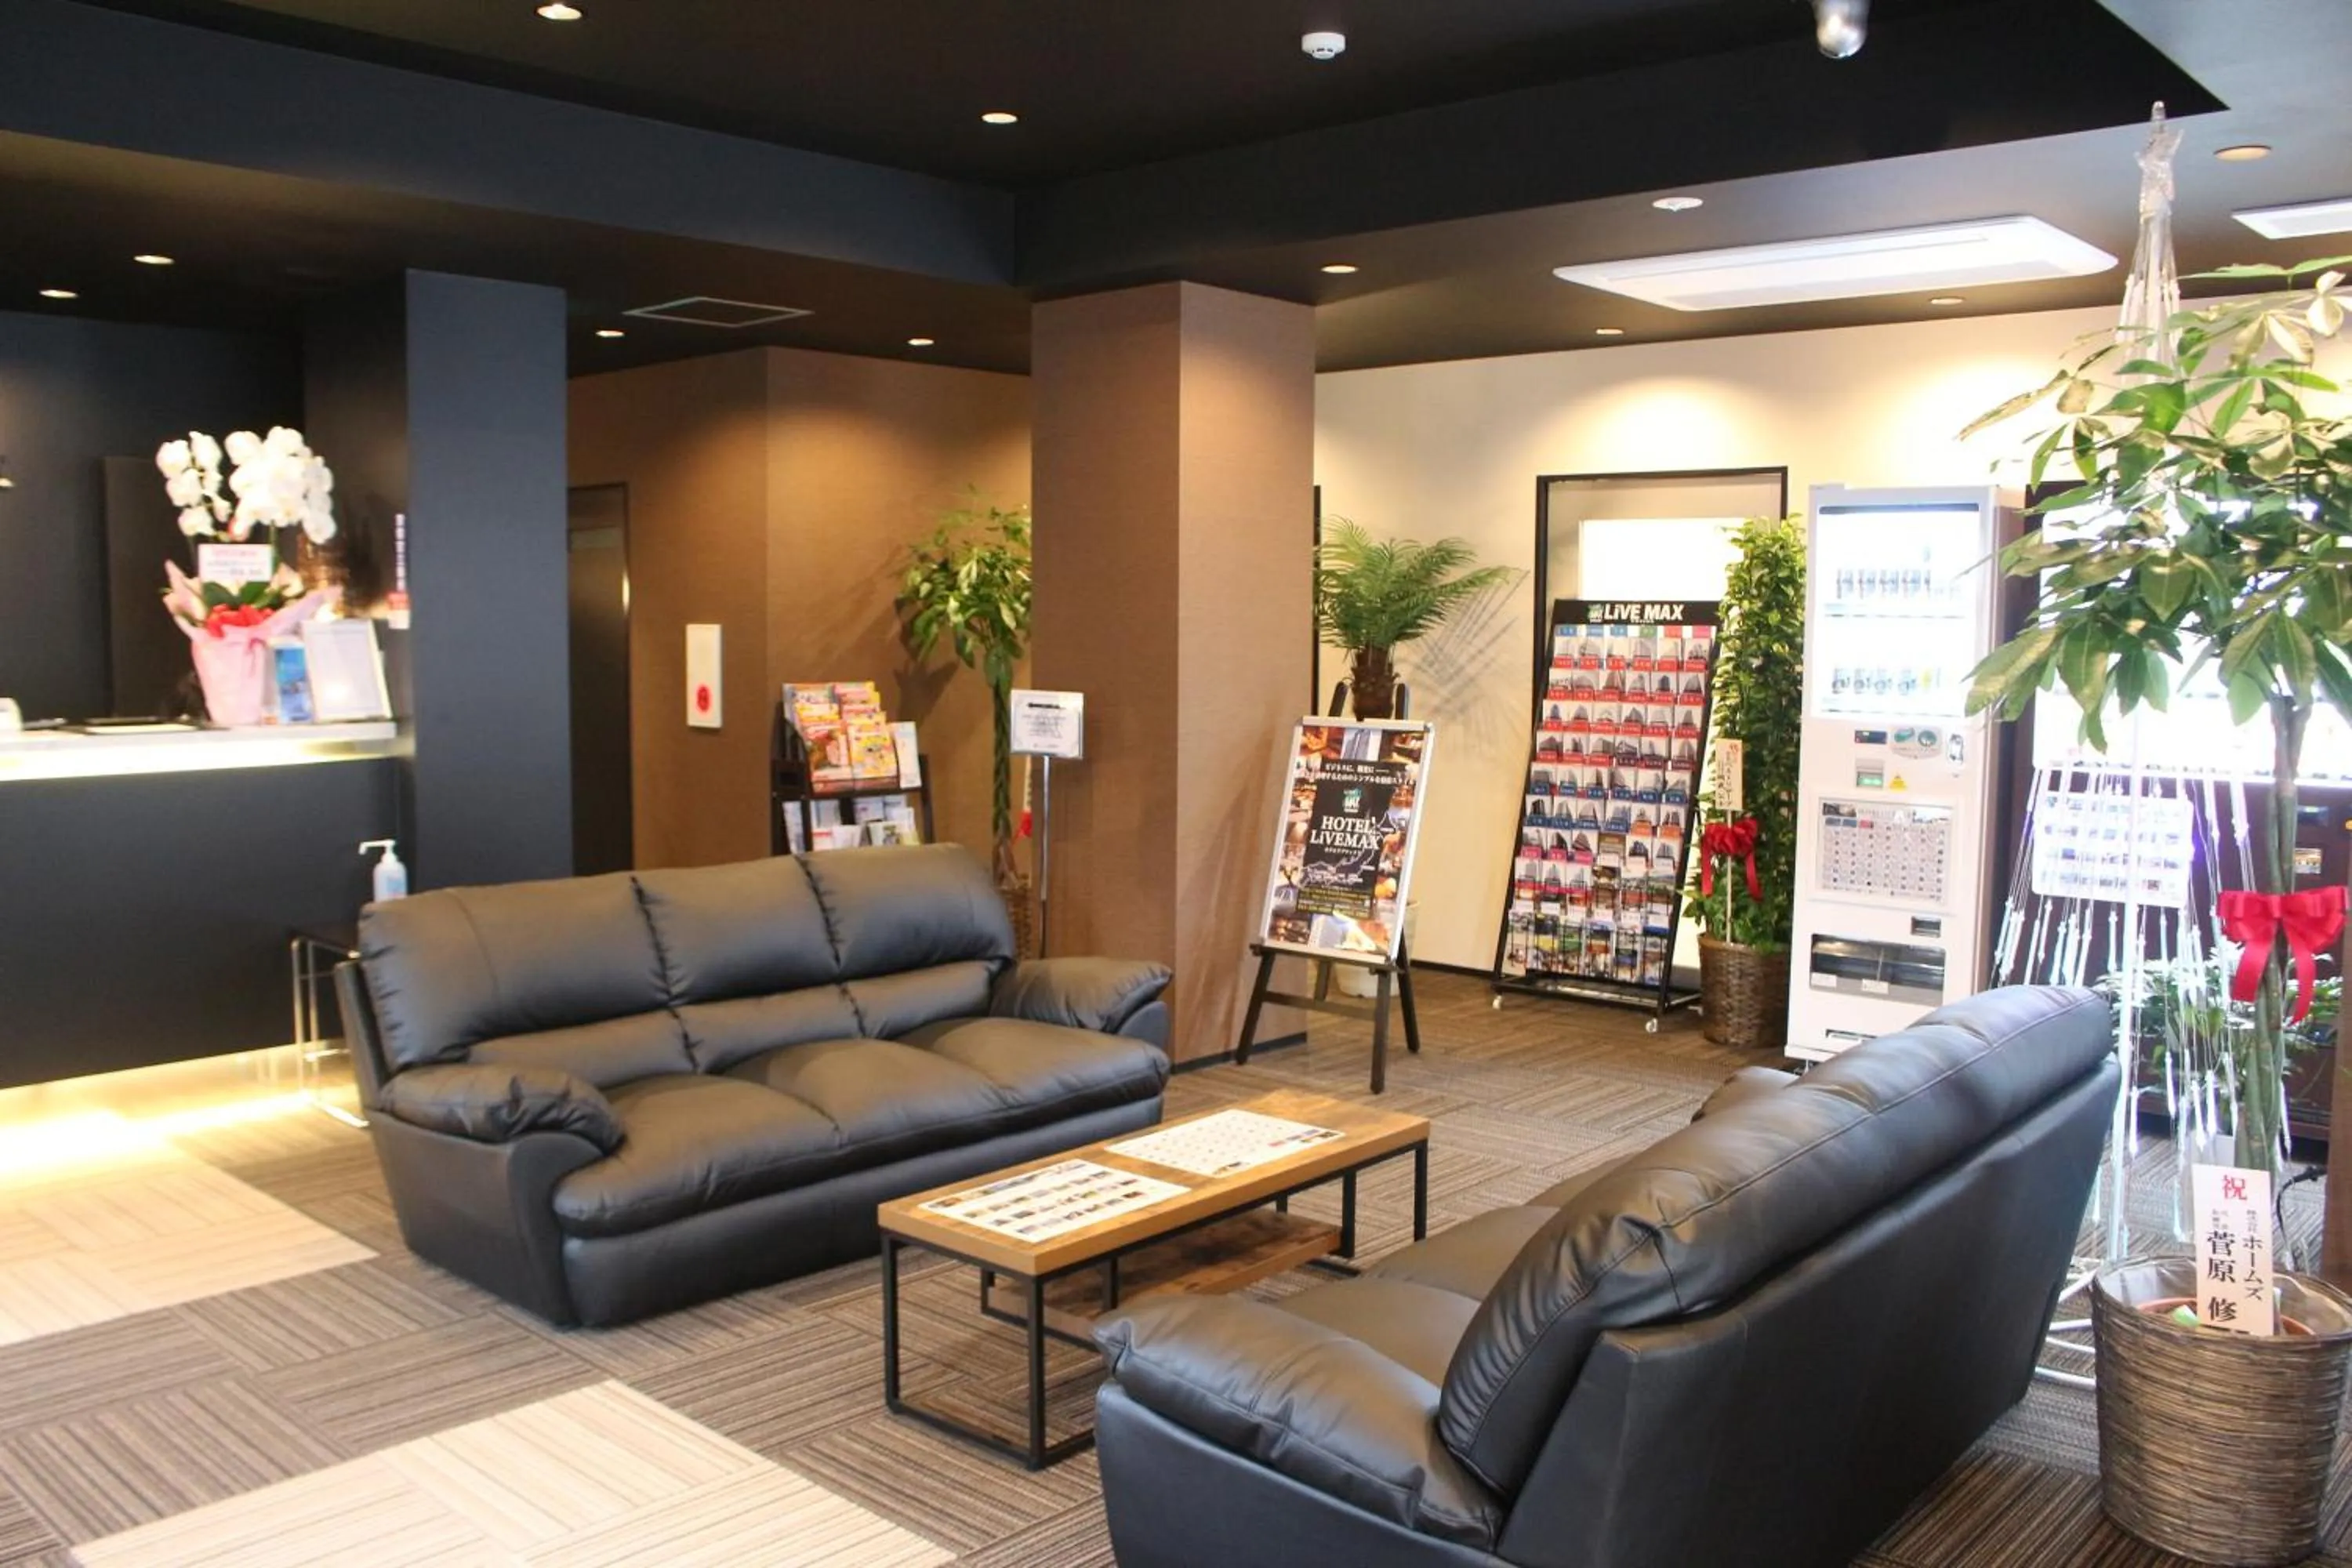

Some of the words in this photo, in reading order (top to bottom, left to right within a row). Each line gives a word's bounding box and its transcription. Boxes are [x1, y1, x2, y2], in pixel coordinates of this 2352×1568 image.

[1643, 604, 1684, 621] MAX
[1322, 815, 1374, 833] HOTEL
[2223, 1174, 2248, 1200] 祝
